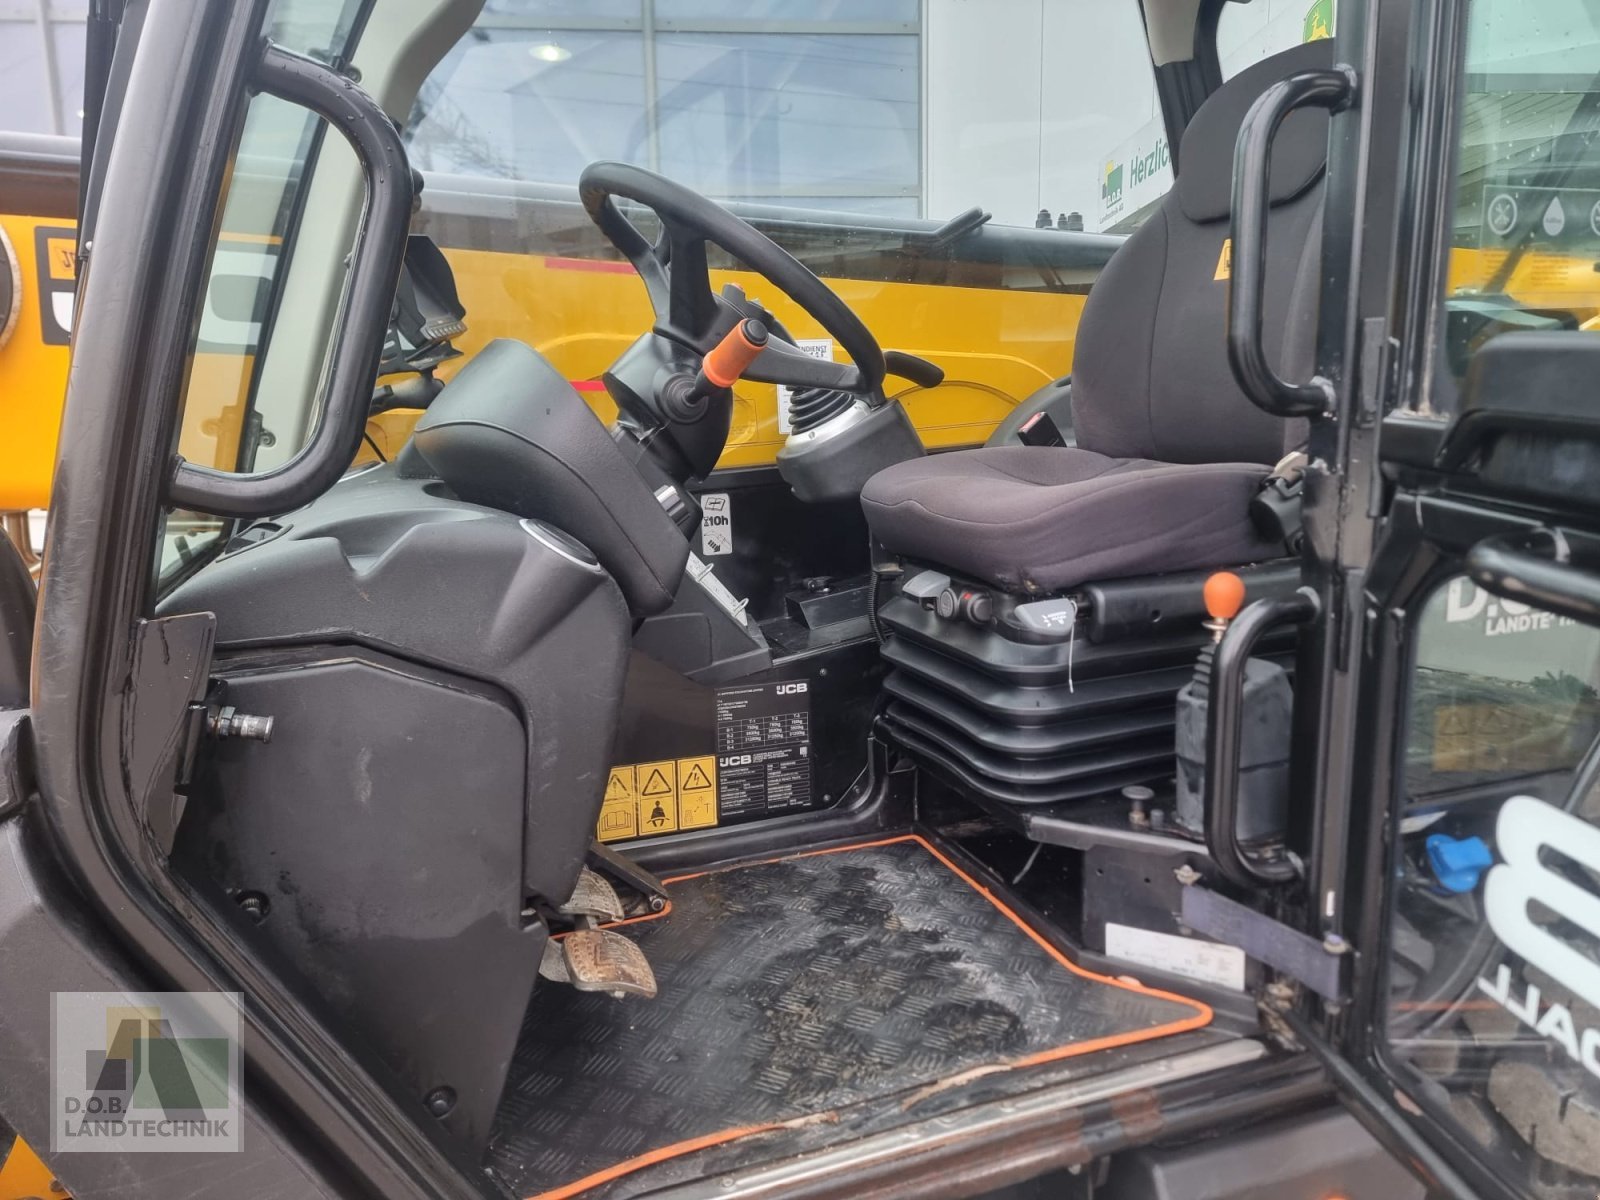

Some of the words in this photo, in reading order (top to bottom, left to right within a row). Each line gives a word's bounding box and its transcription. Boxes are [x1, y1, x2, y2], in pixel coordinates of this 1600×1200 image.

[1129, 138, 1171, 189] Herzlic
[708, 515, 729, 527] 10h
[776, 683, 808, 695] JCB
[720, 755, 752, 767] JCB
